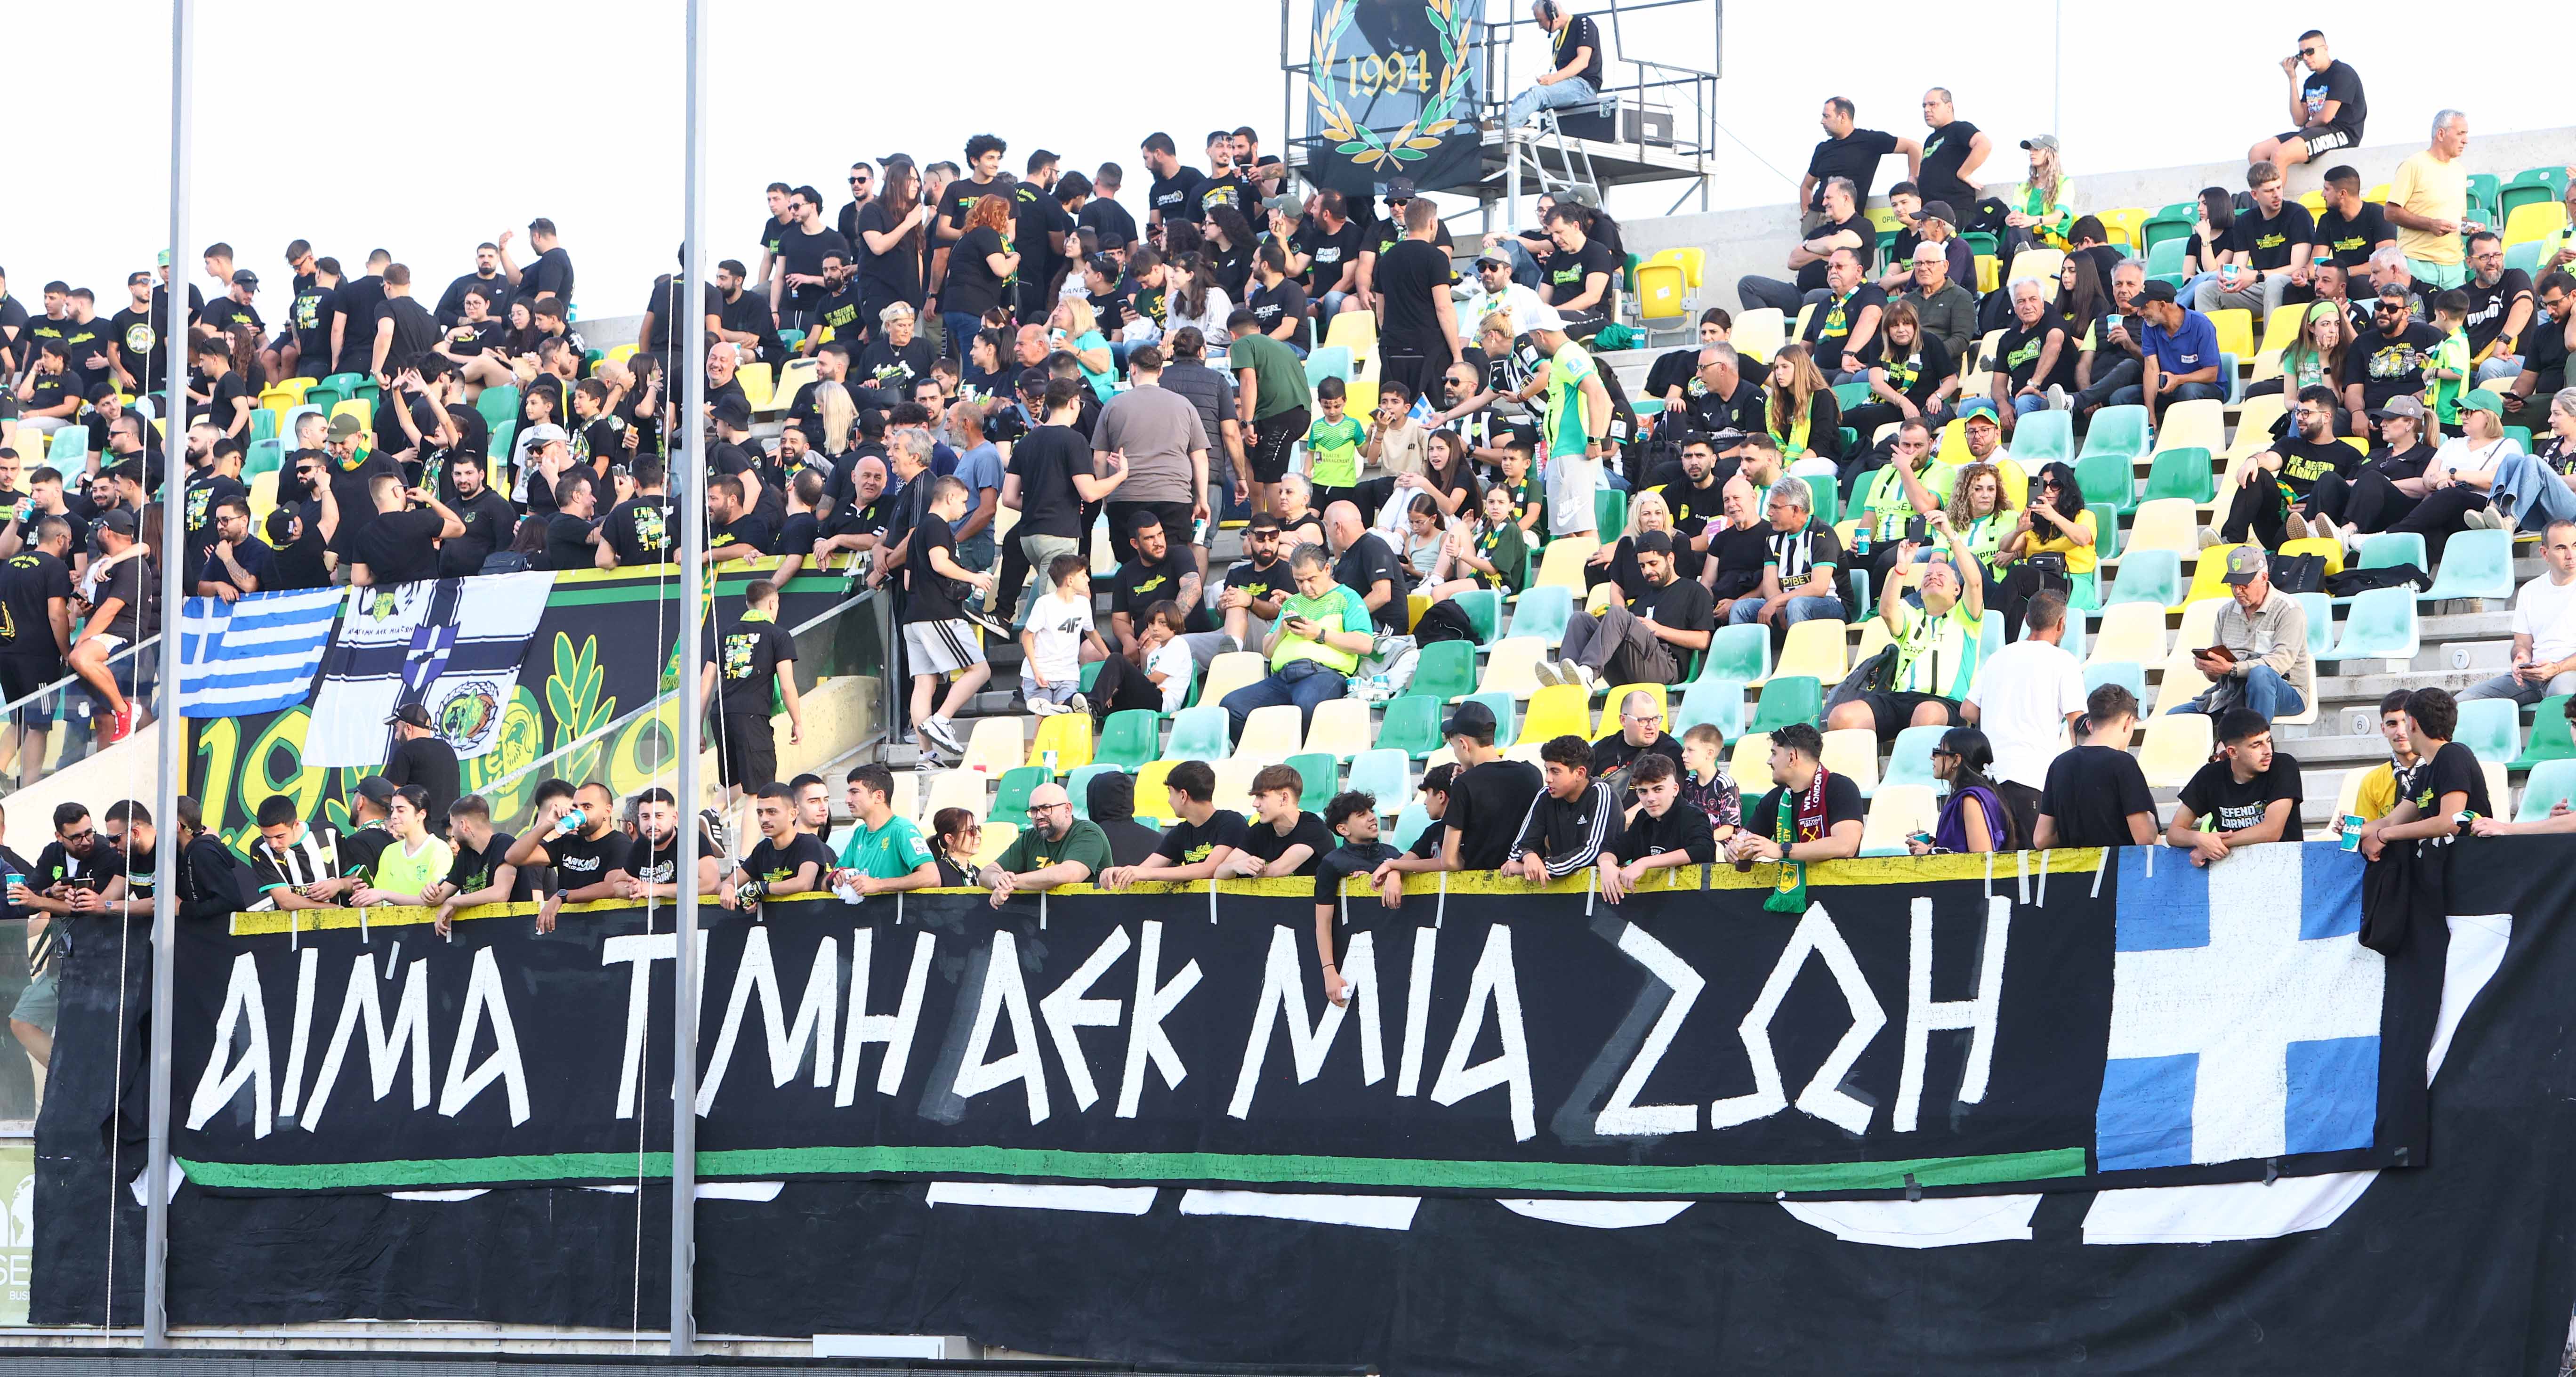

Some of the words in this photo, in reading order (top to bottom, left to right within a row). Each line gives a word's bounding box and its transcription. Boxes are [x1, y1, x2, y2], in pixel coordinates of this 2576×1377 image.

[1348, 49, 1432, 98] 1994
[2467, 304, 2498, 327] PUMA
[2289, 455, 2303, 467] WE
[2304, 460, 2335, 472] DEFEND
[2457, 655, 2462, 664] 7
[2357, 720, 2362, 730] 6
[2219, 805, 2256, 817] DEFEND
[186, 946, 530, 1139] ΑΙΜΑ
[952, 921, 1203, 1125] ΑΕΚ
[1227, 924, 1536, 1142] ΜΙΑ
[1595, 895, 2012, 1135] ΖΩΗ
